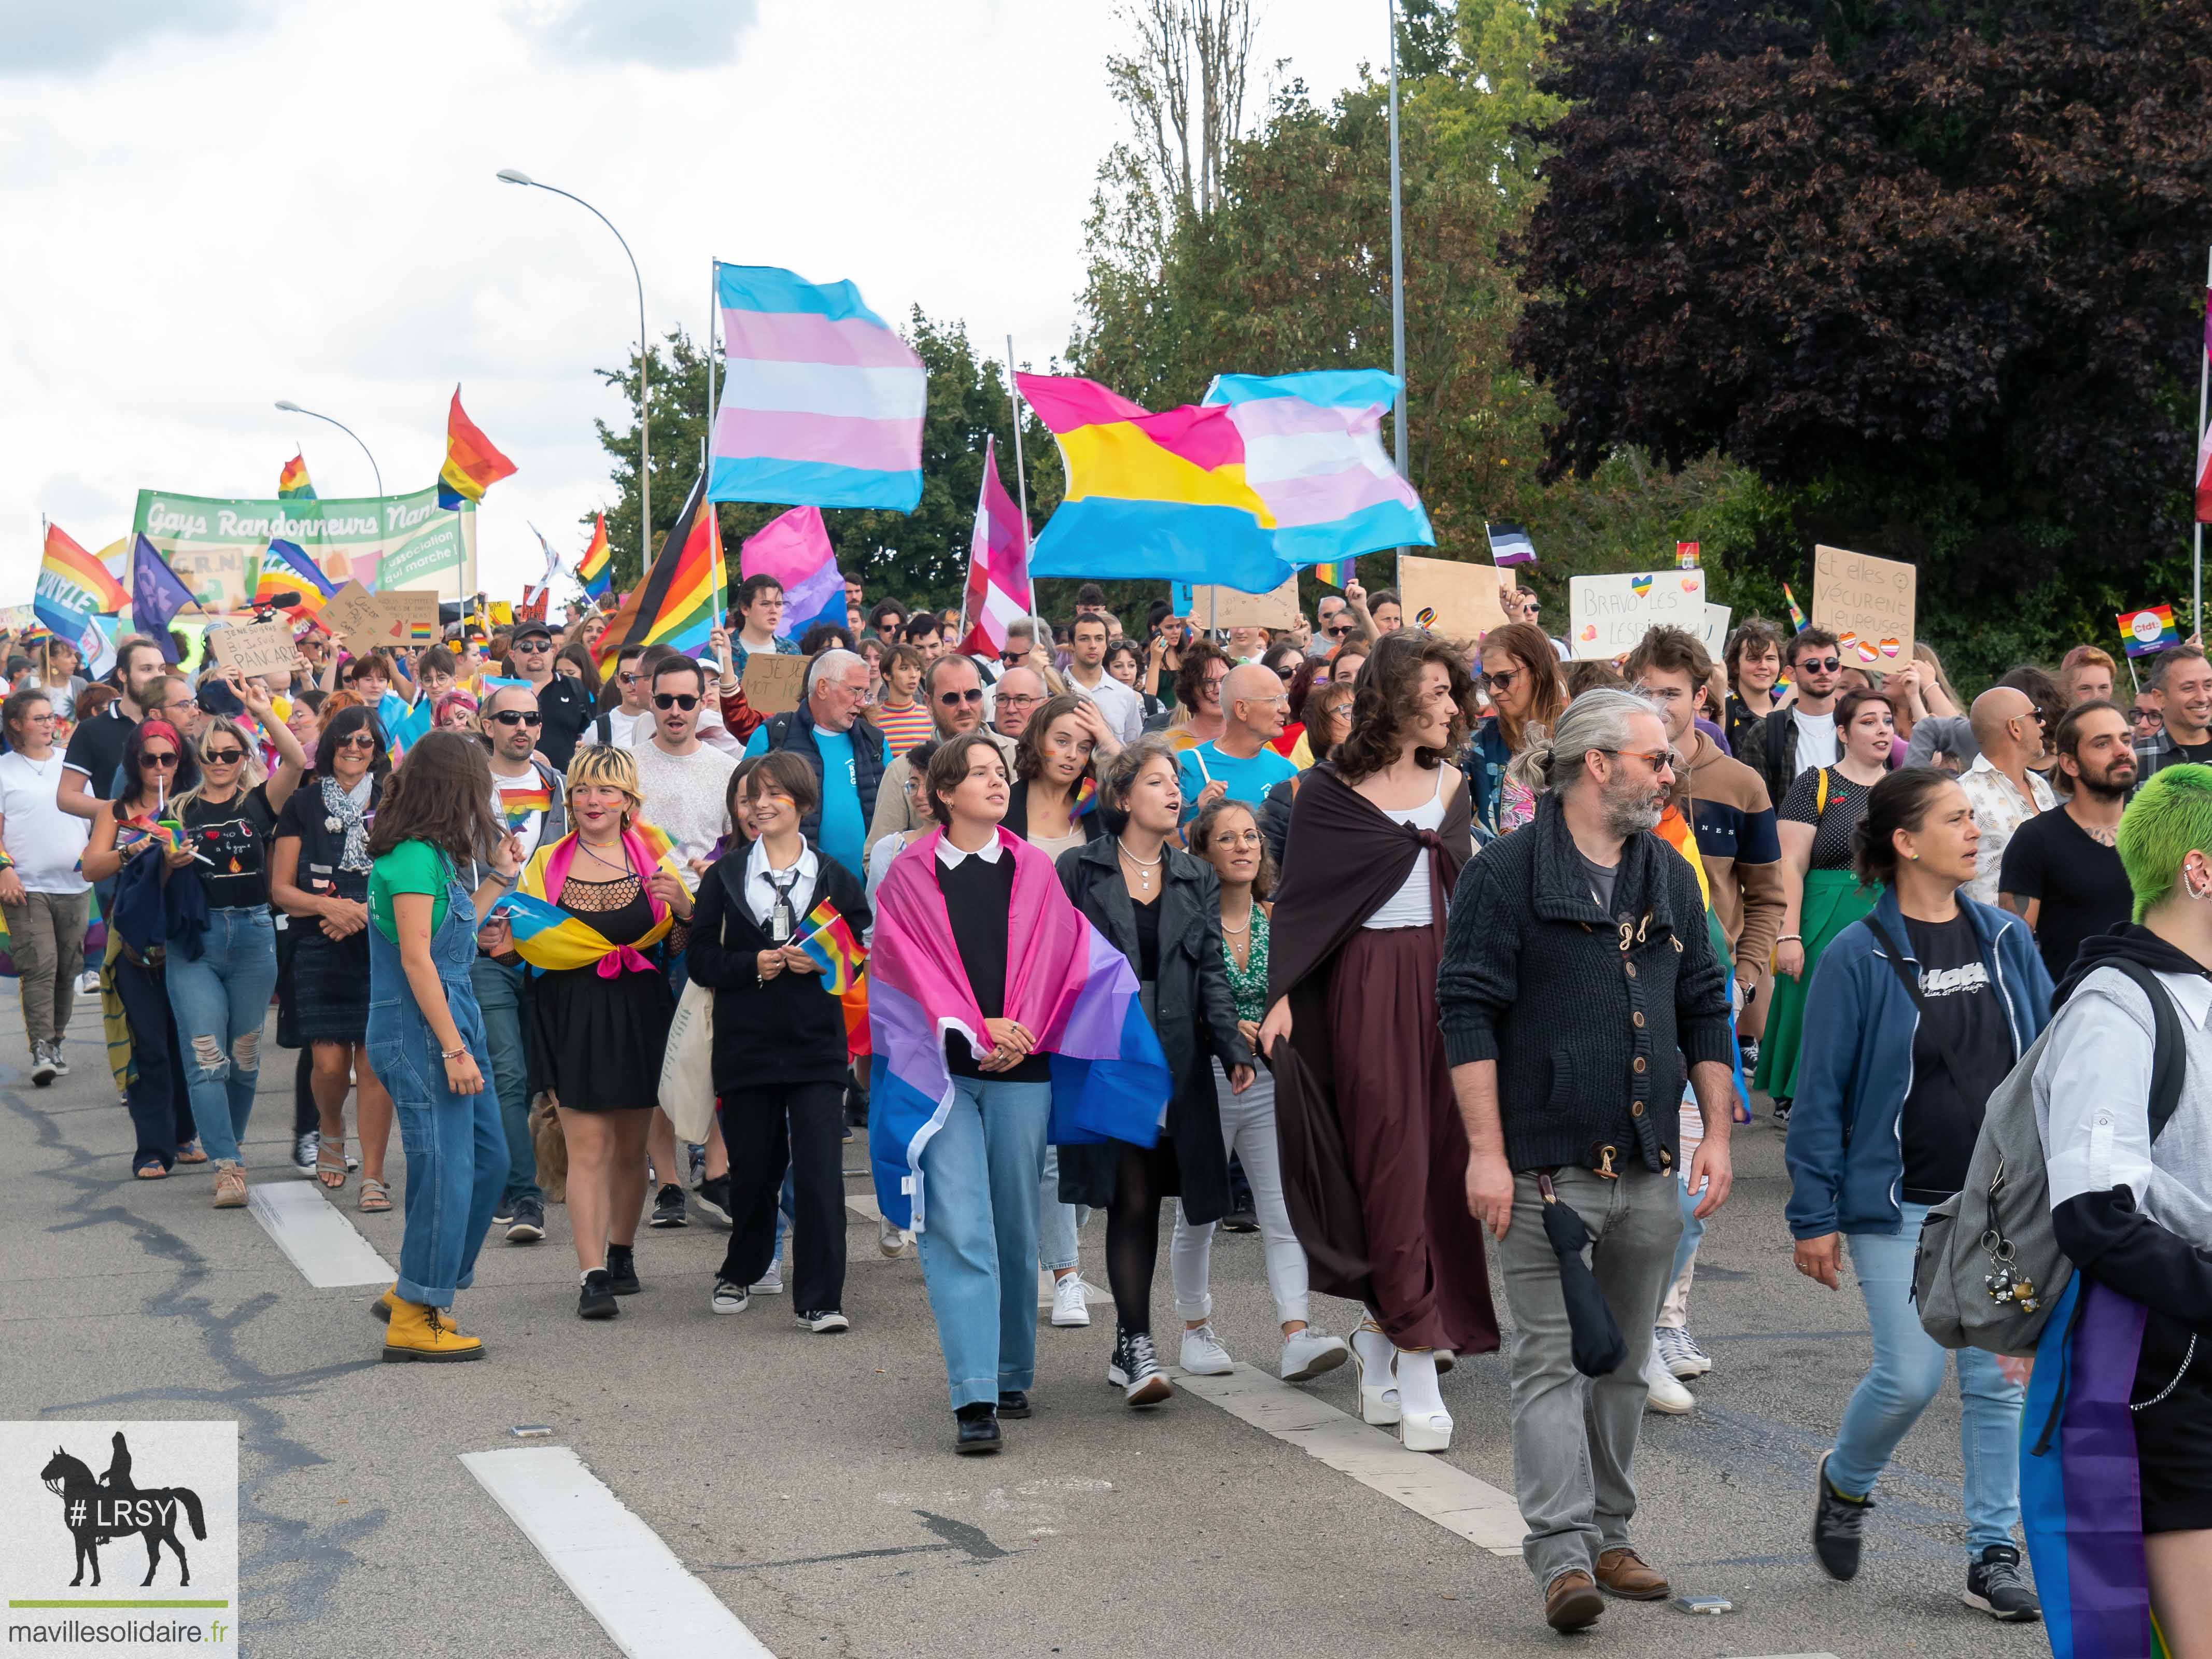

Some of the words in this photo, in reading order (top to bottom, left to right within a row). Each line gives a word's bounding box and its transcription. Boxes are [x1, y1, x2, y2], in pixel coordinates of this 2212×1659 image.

[147, 502, 207, 539] Gays
[217, 510, 378, 537] Randonneurs
[385, 568, 402, 583] qui
[406, 547, 452, 572] marche
[1817, 552, 1838, 578] Et
[1847, 558, 1885, 584] elles
[1584, 588, 1638, 616] BRAVO
[1650, 592, 1677, 610] LES
[762, 658, 784, 679] JE
